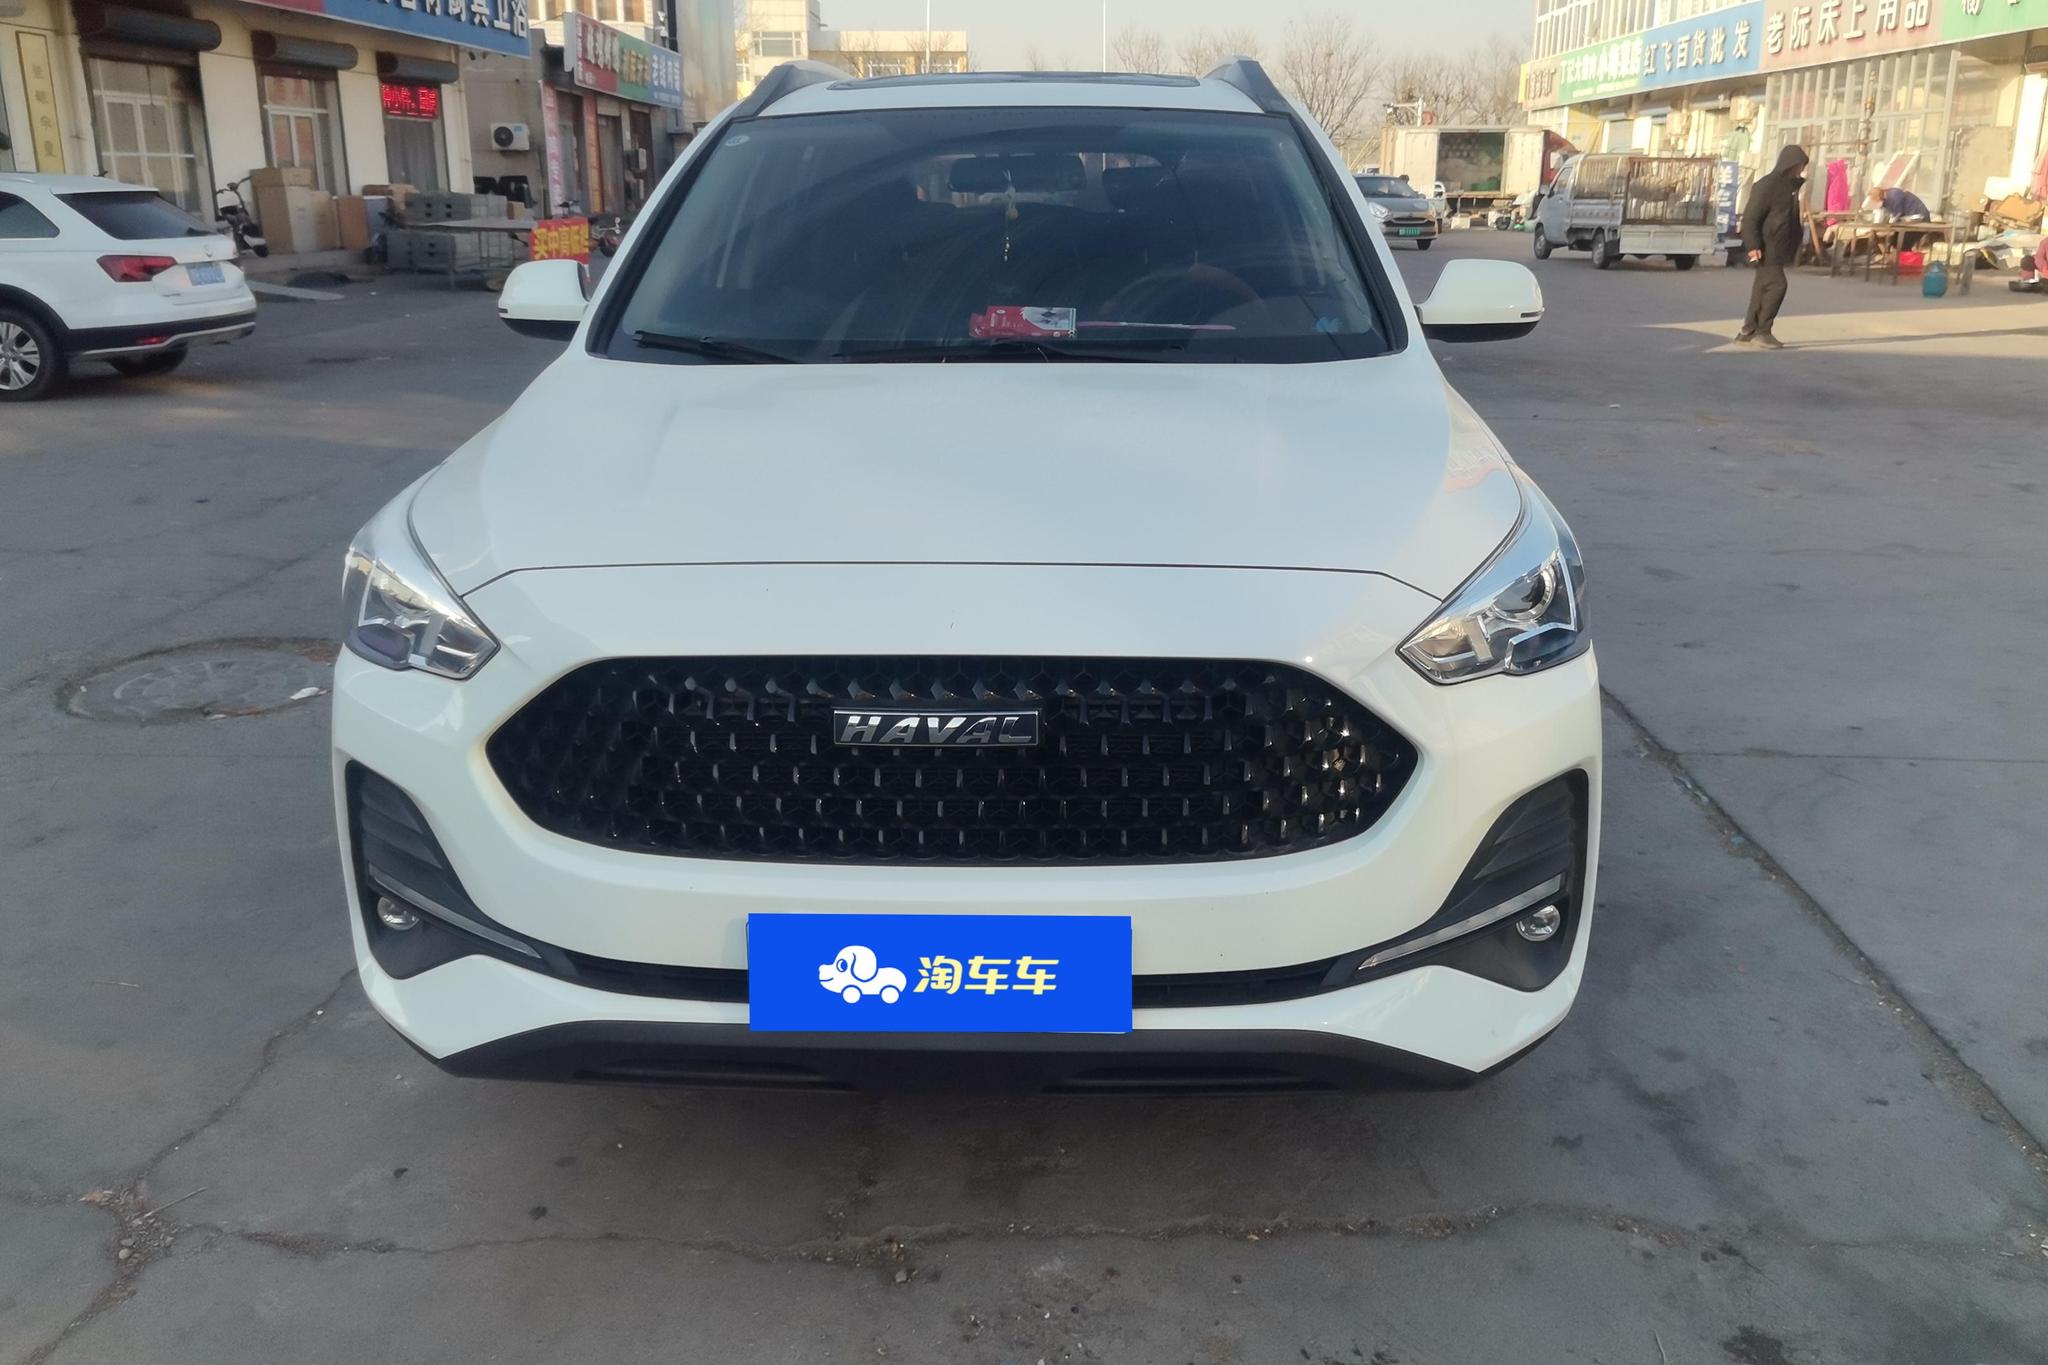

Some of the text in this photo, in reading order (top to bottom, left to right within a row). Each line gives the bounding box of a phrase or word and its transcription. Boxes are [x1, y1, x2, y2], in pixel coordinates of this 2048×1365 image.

[1644, 19, 1751, 76] 红飞百货批发
[840, 715, 1033, 744] HAVAL
